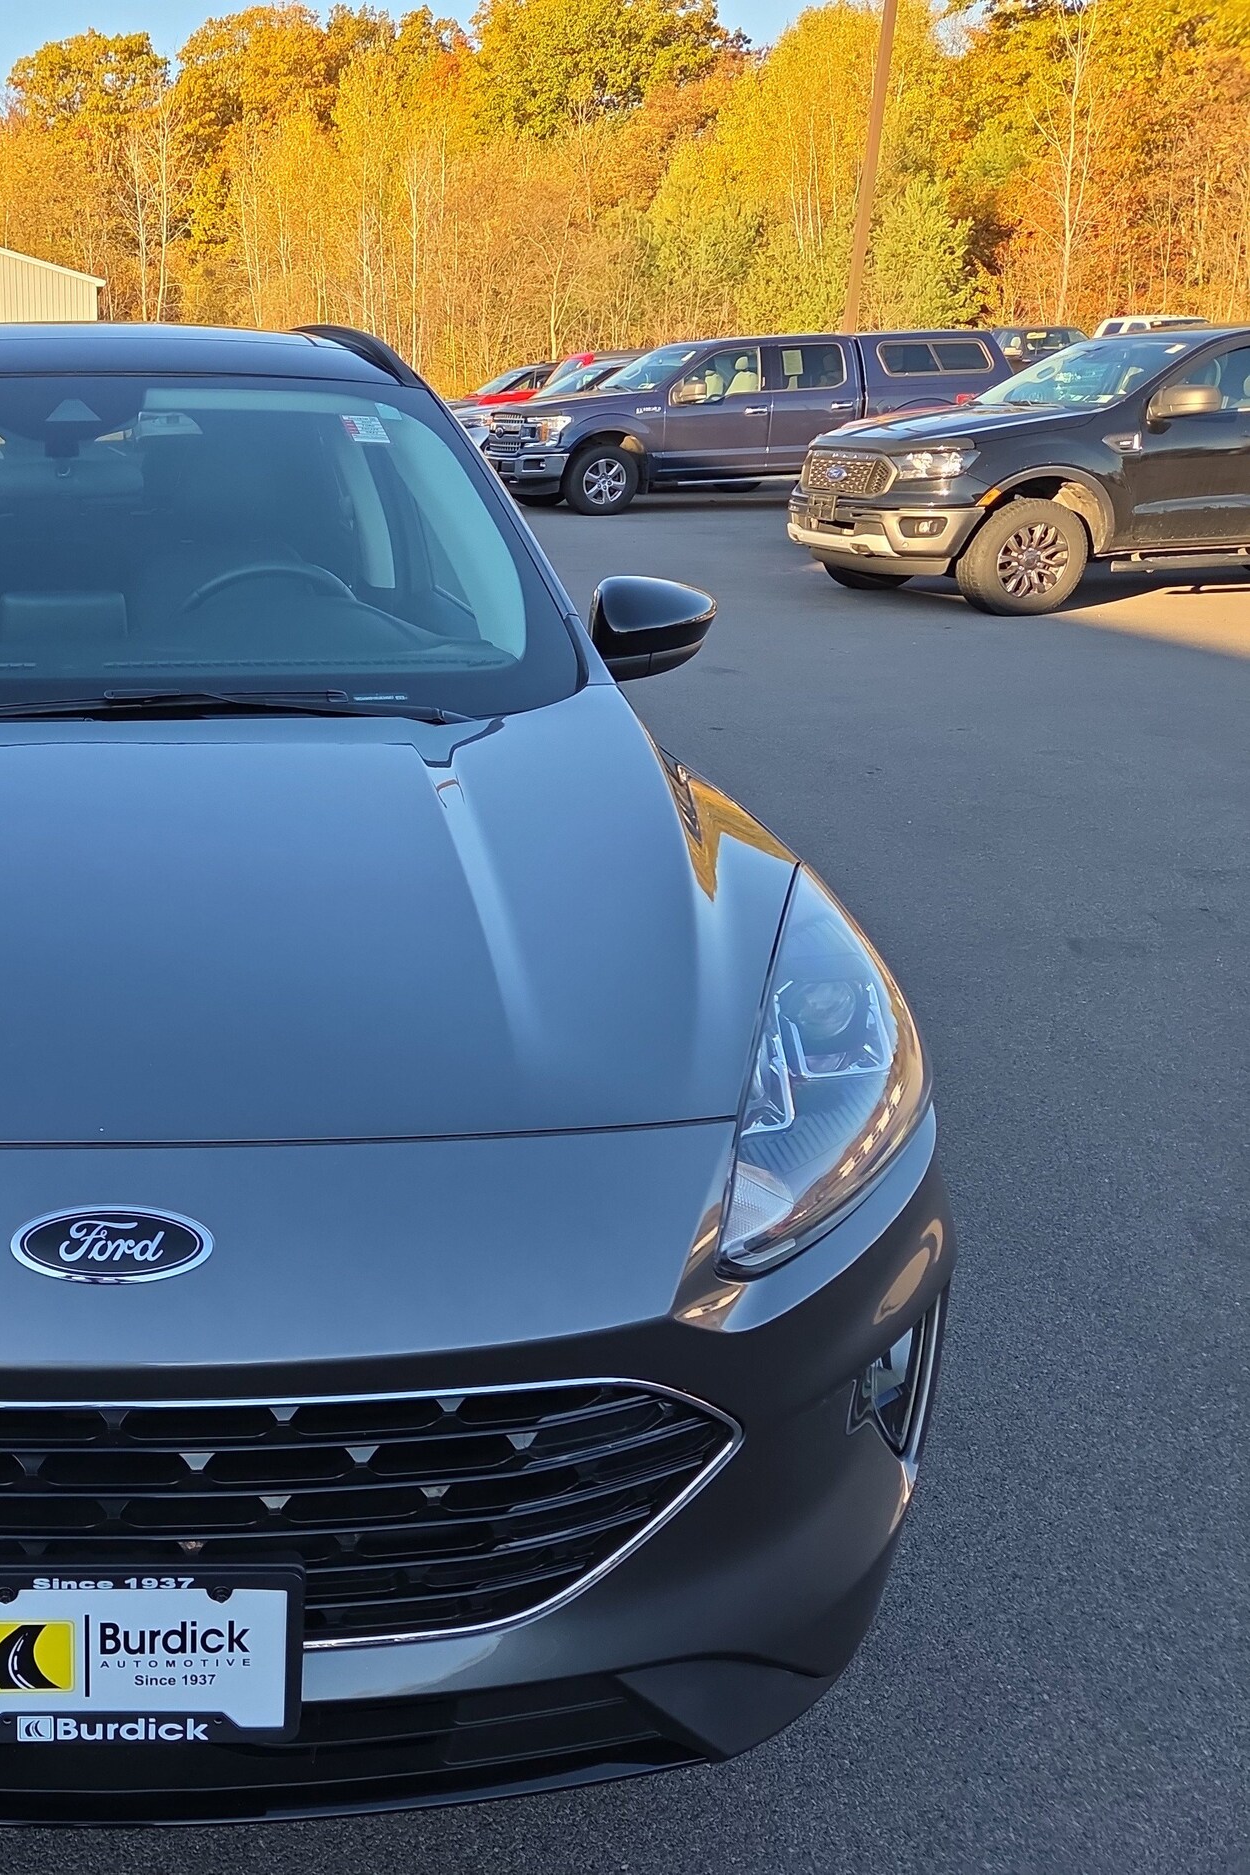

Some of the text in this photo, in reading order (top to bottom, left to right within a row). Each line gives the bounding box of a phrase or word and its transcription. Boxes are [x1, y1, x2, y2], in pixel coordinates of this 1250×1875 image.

[59, 1220, 165, 1262] Ford
[32, 1577, 195, 1590] Since 1937
[100, 1620, 250, 1655] Burdick
[100, 1658, 251, 1669] AUTOMOTIVE
[134, 1674, 217, 1687] Since 1937
[56, 1719, 209, 1741] Burdick
